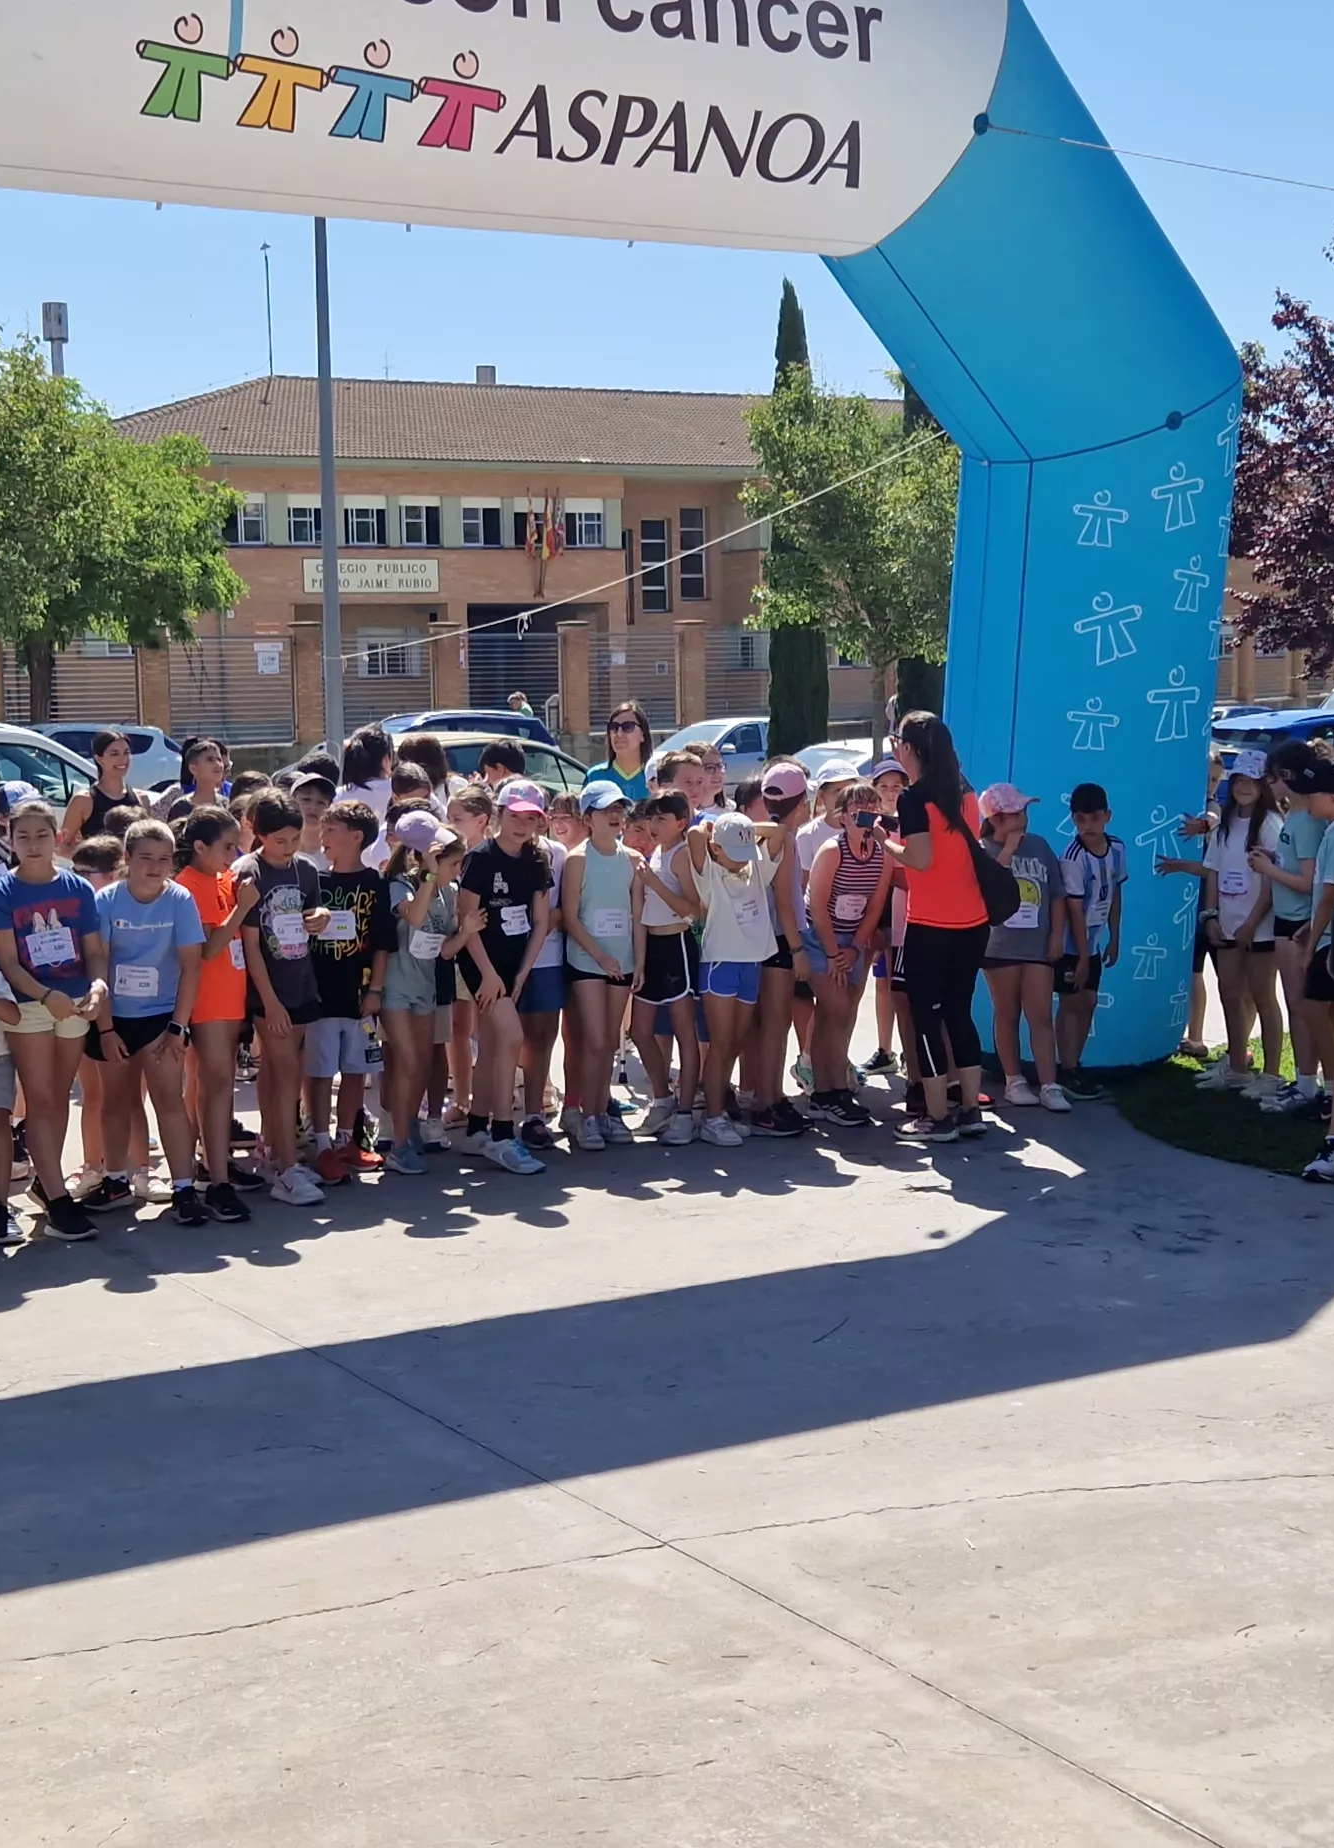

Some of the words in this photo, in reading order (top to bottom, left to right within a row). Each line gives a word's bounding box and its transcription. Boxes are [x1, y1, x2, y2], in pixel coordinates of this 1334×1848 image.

[494, 84, 861, 190] ASPANOA
[316, 563, 367, 574] CEGIO
[377, 563, 427, 574] PUBLICO
[357, 578, 391, 589] JAIME
[398, 578, 432, 588] RUBIO
